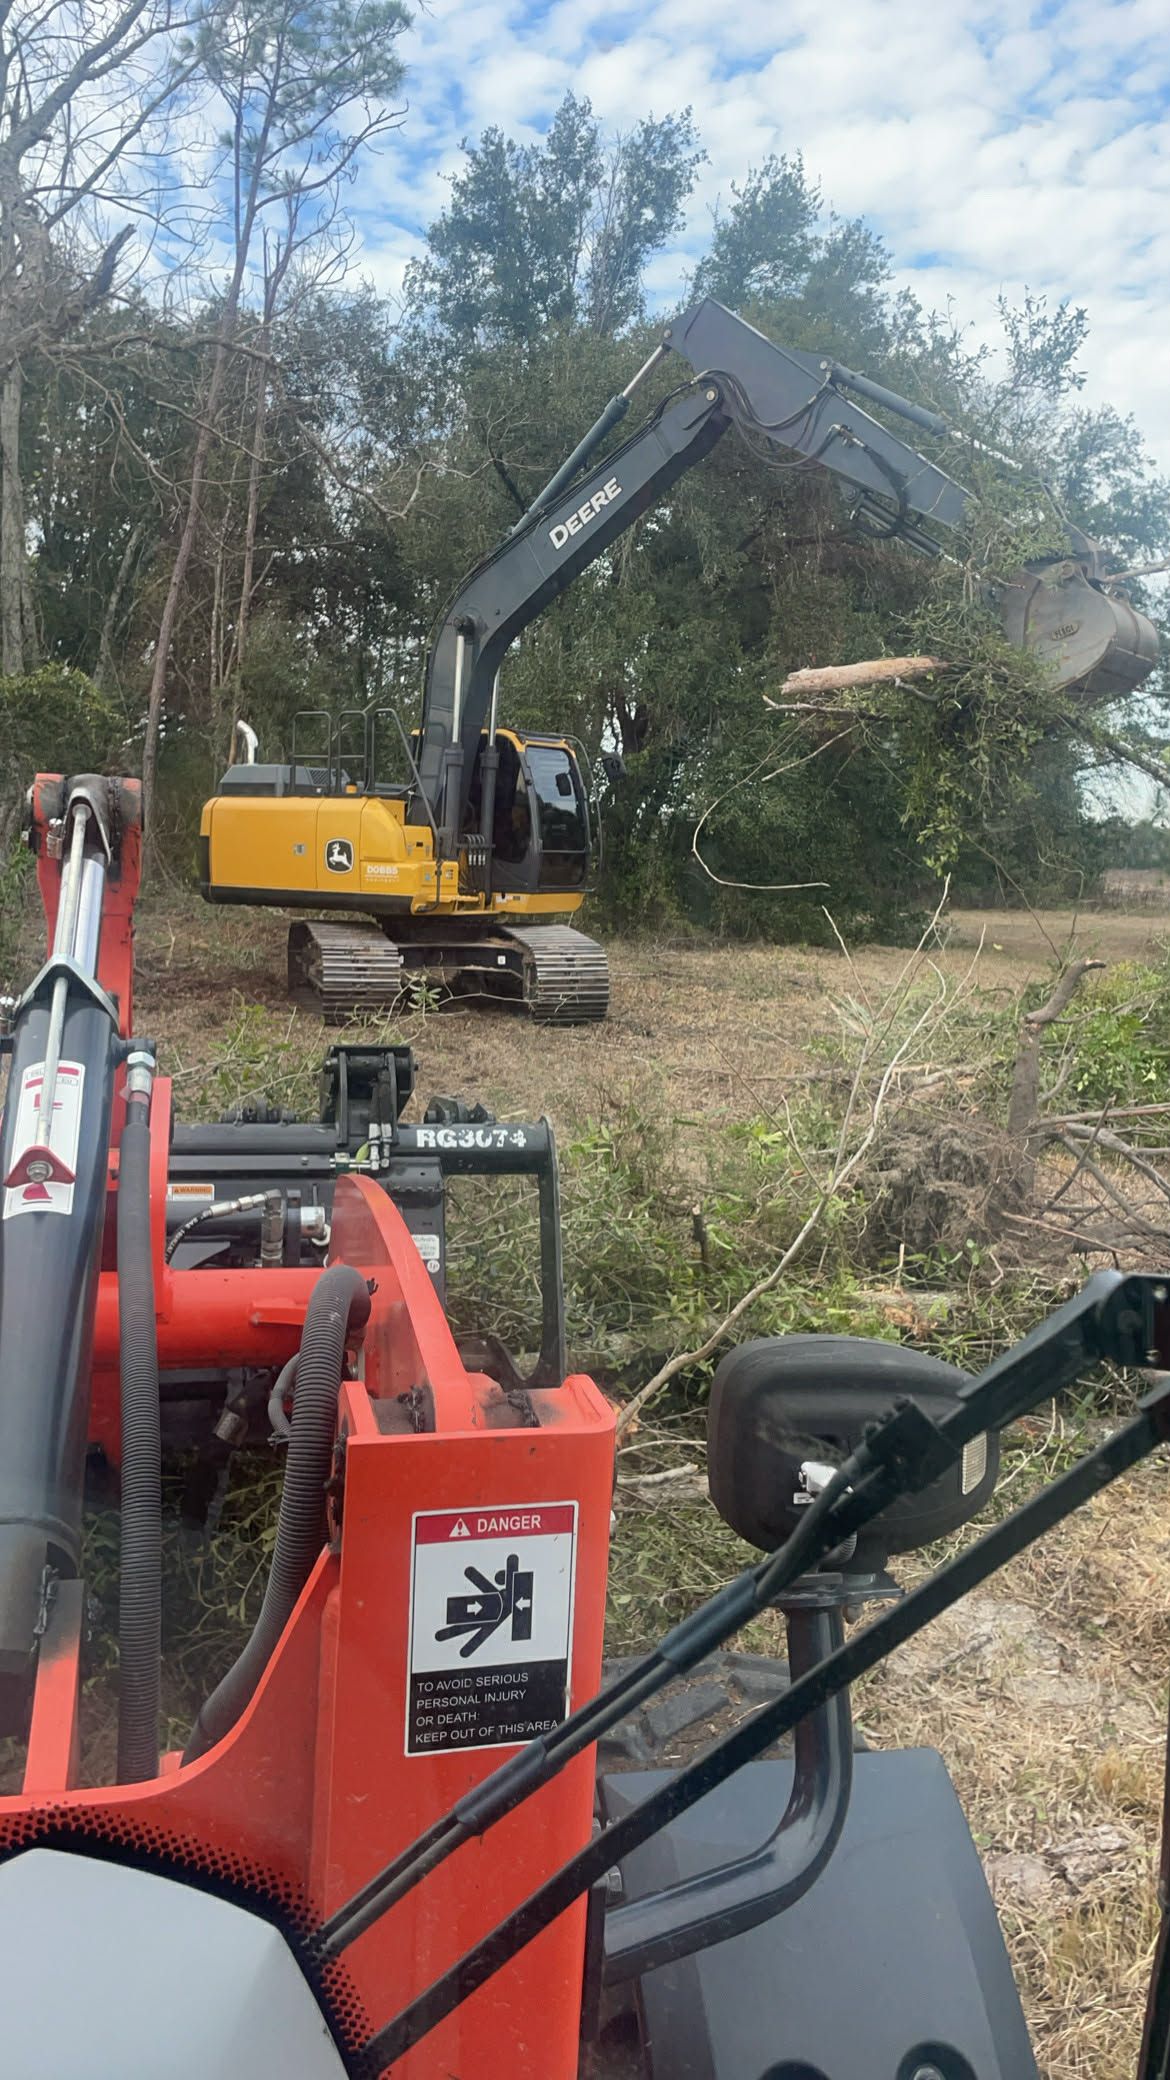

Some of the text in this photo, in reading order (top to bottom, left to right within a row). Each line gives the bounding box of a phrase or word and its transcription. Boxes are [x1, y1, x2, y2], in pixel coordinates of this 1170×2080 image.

[549, 477, 622, 550] DEERE
[416, 1129, 527, 1148] RG3074
[477, 1514, 542, 1533] DANGER
[417, 1672, 529, 1692] TO AVOID SERIOUS
[416, 1689, 526, 1709] PERSONAL INJURY
[416, 1715, 434, 1727] OR
[415, 1719, 559, 1744] KEEP OUT OF THIS AREA
